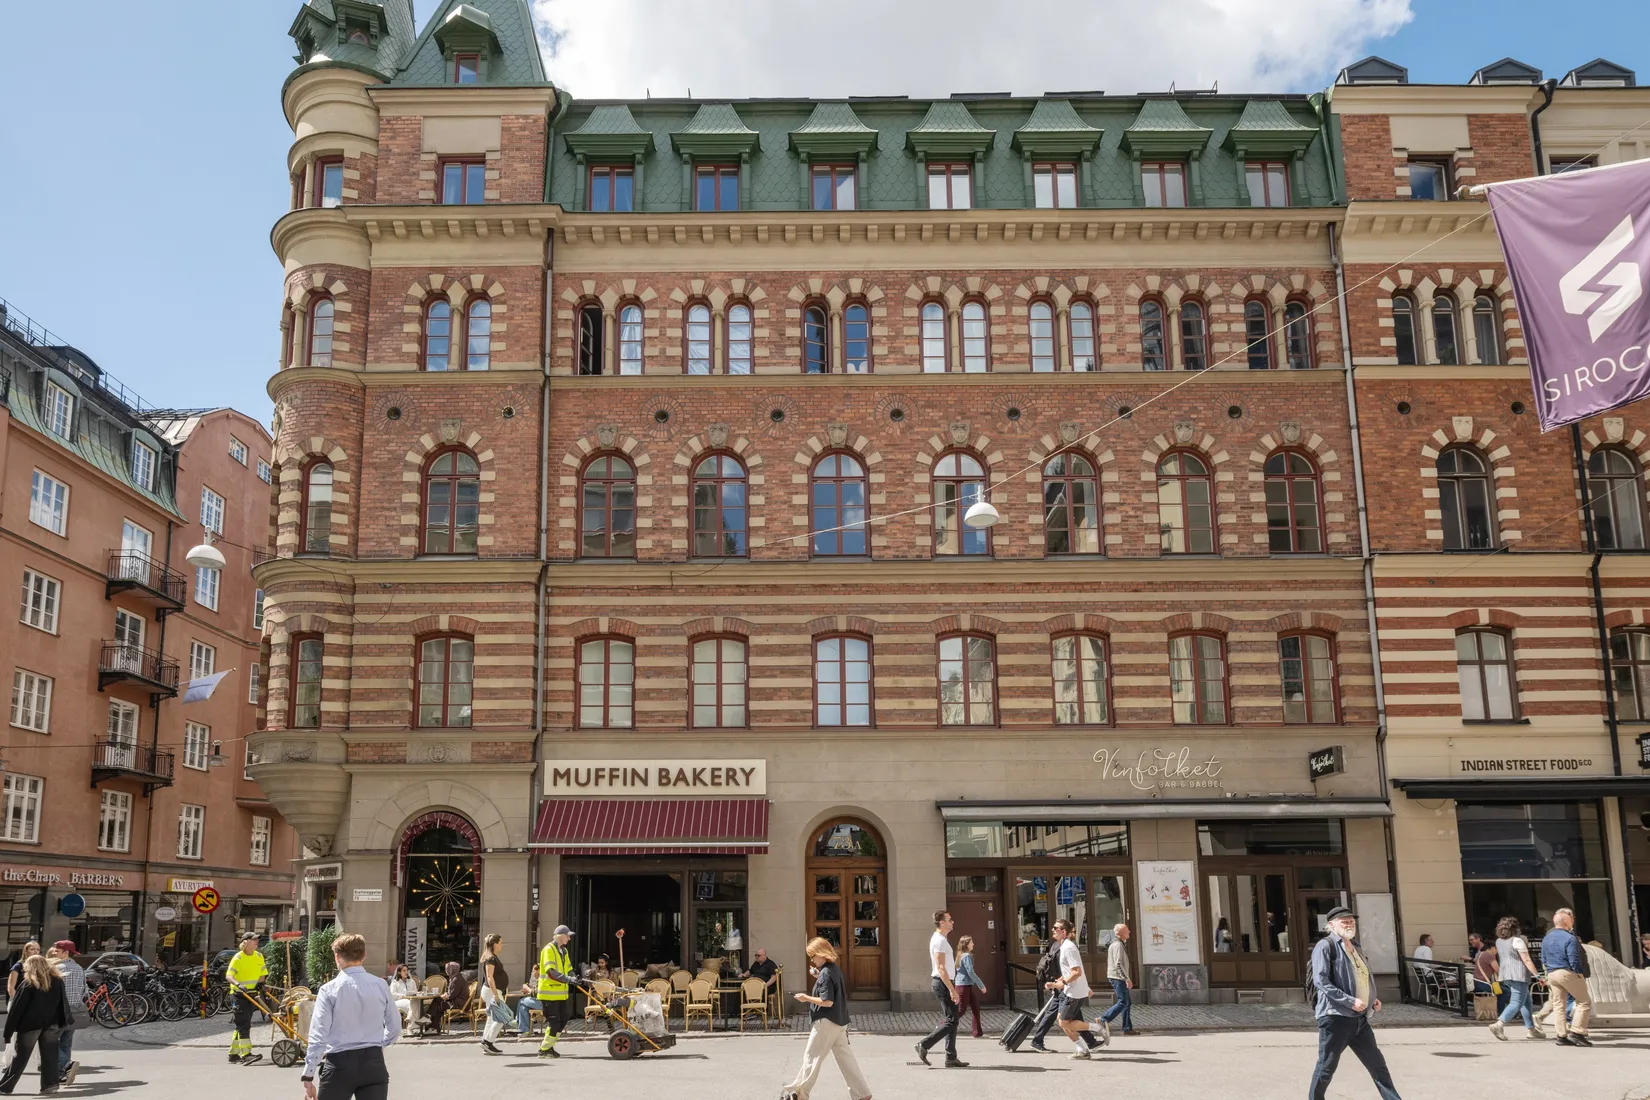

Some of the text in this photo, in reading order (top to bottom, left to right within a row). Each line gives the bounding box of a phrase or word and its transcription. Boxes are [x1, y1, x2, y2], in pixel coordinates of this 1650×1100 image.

[1544, 346, 1650, 402] SIROC
[1093, 746, 1223, 790] Vinfolket
[1461, 760, 1504, 771] INDIAN
[1506, 759, 1547, 771] STREET
[1550, 759, 1578, 770] FOOD
[552, 767, 756, 787] MUFFIN BAKERY
[1158, 780, 1224, 788] BAR & BABBEL
[70, 872, 124, 886] BARBER'S
